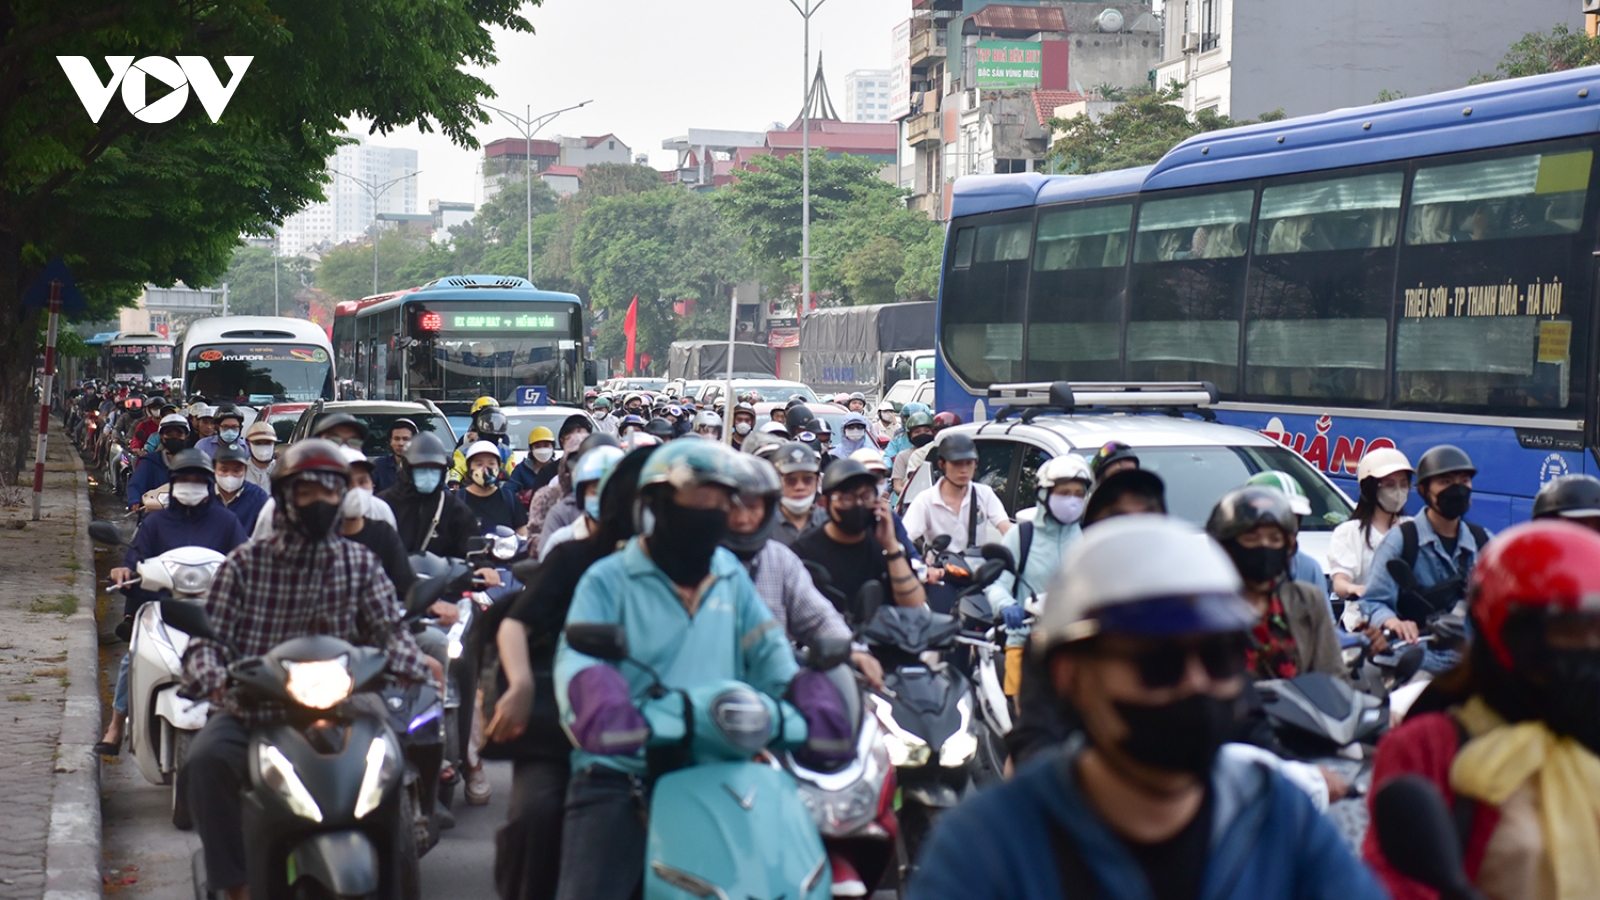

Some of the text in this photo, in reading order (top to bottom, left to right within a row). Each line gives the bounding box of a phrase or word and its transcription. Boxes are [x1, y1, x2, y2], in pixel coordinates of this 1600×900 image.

[976, 48, 991, 64] TẠP
[977, 67, 991, 78] ĐẶC
[991, 66, 1005, 78] SẢN
[1005, 67, 1022, 78] VÙNG
[1404, 282, 1428, 323] TRIỆU
[1428, 285, 1448, 317] SƠN
[1454, 287, 1466, 317] TP
[1467, 285, 1498, 316] THANH
[1498, 278, 1518, 316] HÓA
[1526, 277, 1540, 315] HÀ
[1542, 275, 1563, 321] NỘI
[525, 388, 541, 404] G7
[1520, 434, 1553, 445] THACO
